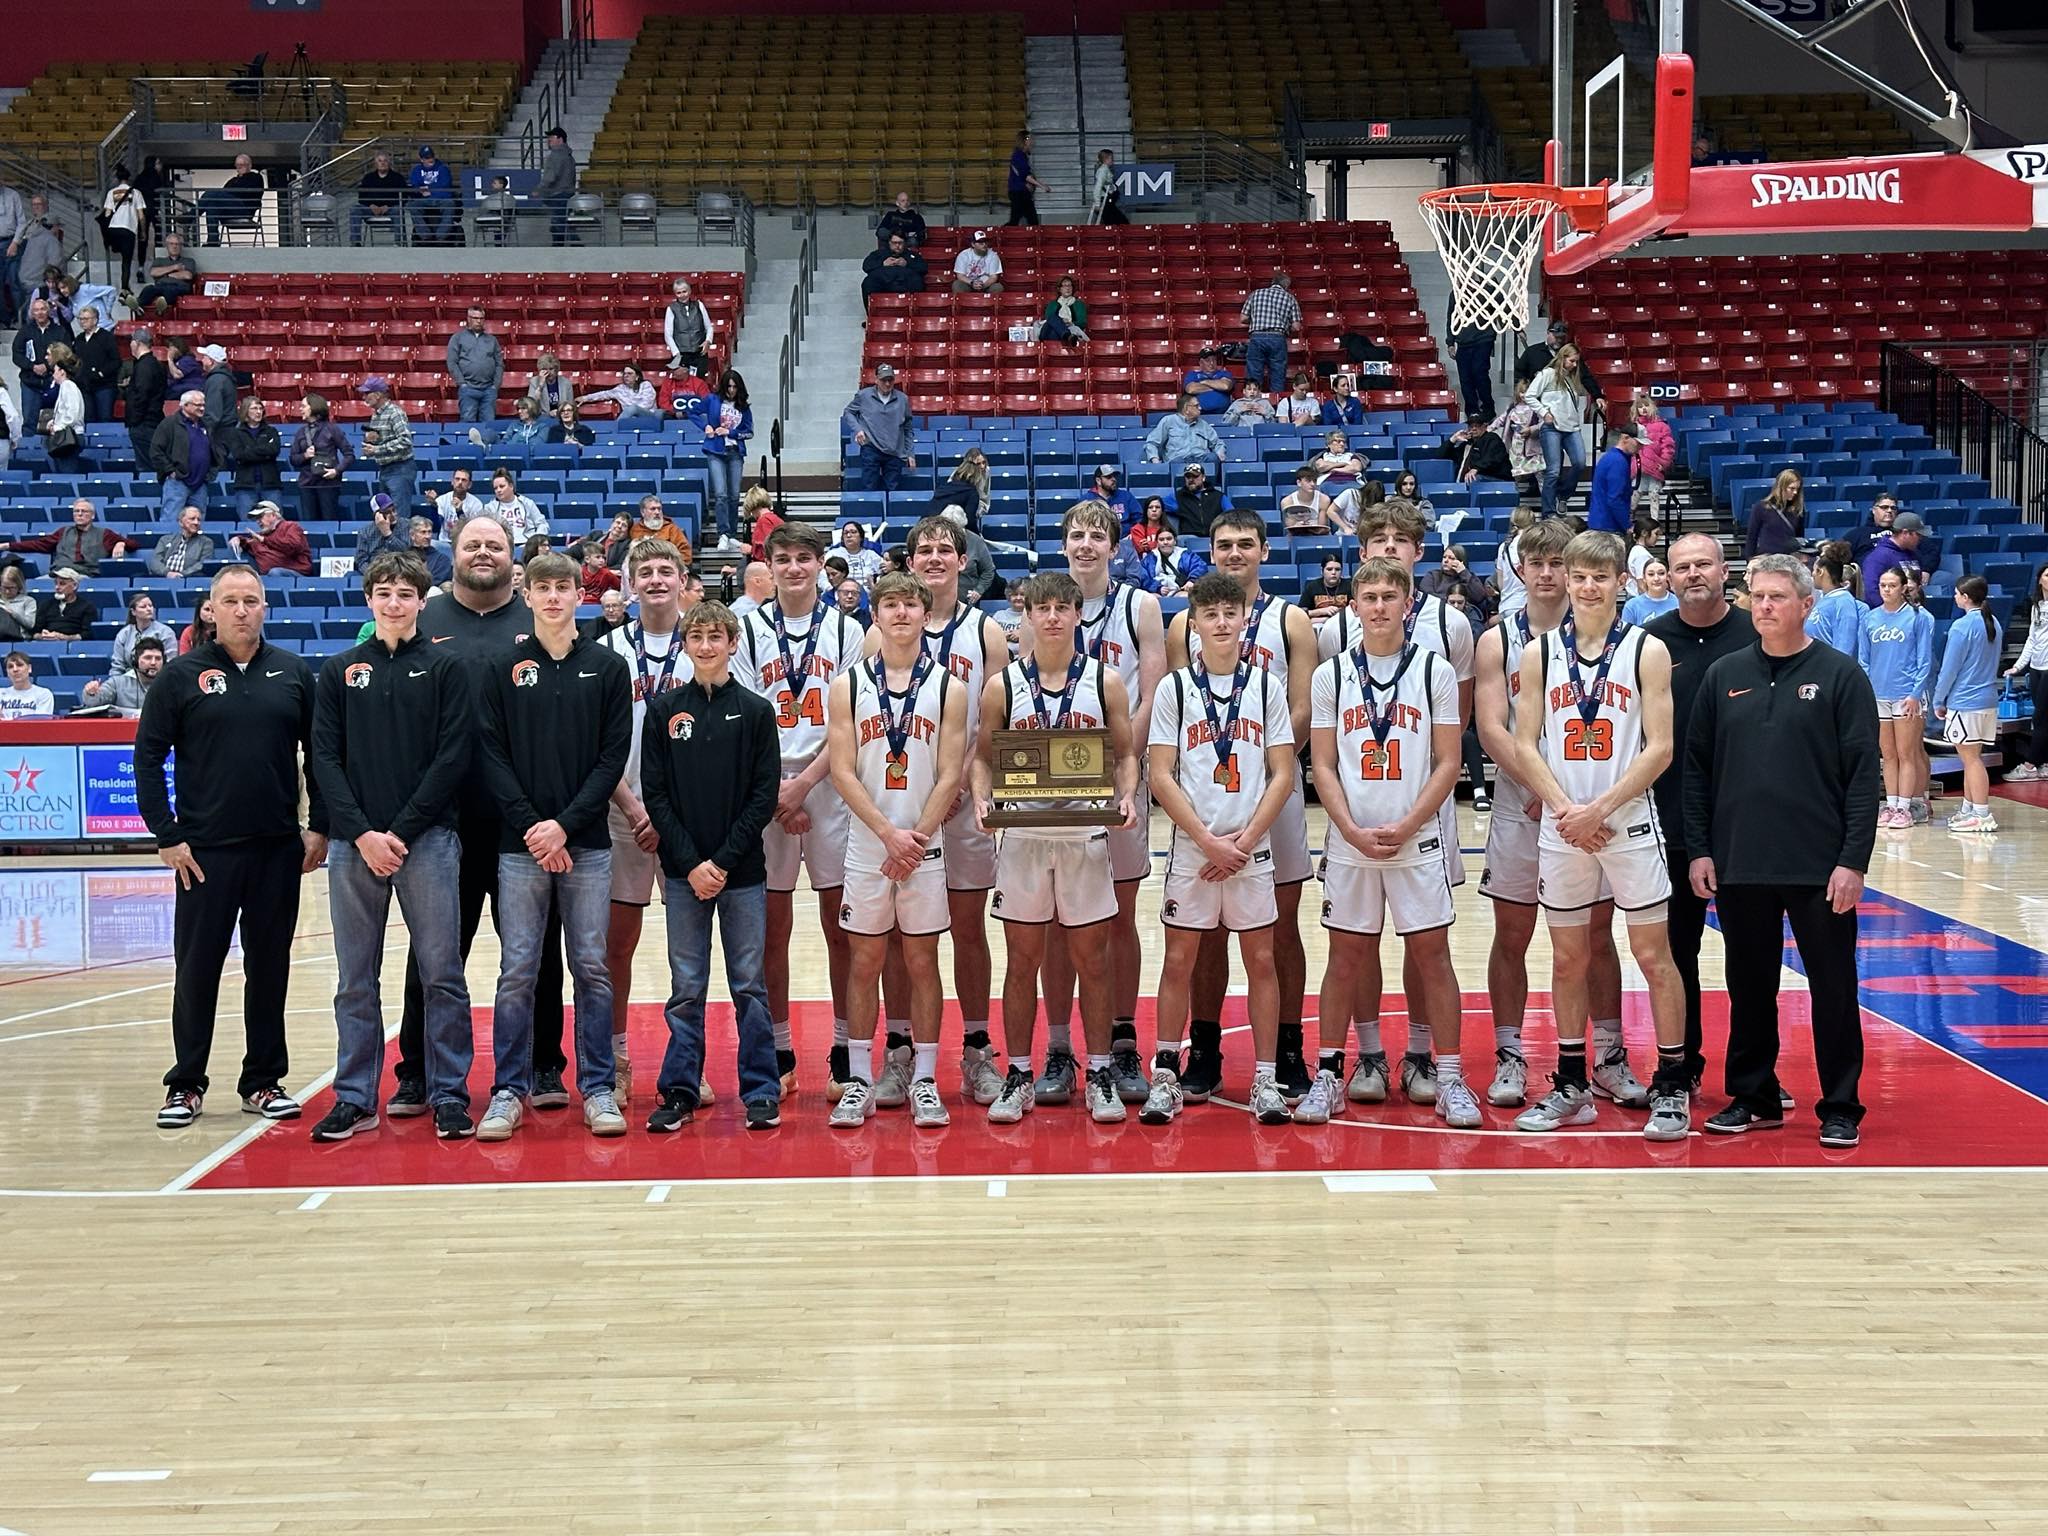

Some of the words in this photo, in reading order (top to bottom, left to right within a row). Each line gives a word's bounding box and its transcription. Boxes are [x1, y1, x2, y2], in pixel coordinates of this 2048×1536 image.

[1751, 168, 1901, 208] SPALDING
[1651, 386, 1680, 398] DD
[1872, 624, 1905, 643] Cats
[761, 655, 835, 690] BEIT
[777, 687, 825, 728] 34
[860, 714, 936, 748] BEIT
[1564, 718, 1613, 760] 23
[885, 750, 909, 790] 2
[1213, 753, 1240, 793] 4
[1361, 739, 1402, 780] 21
[92, 820, 112, 829] 1700
